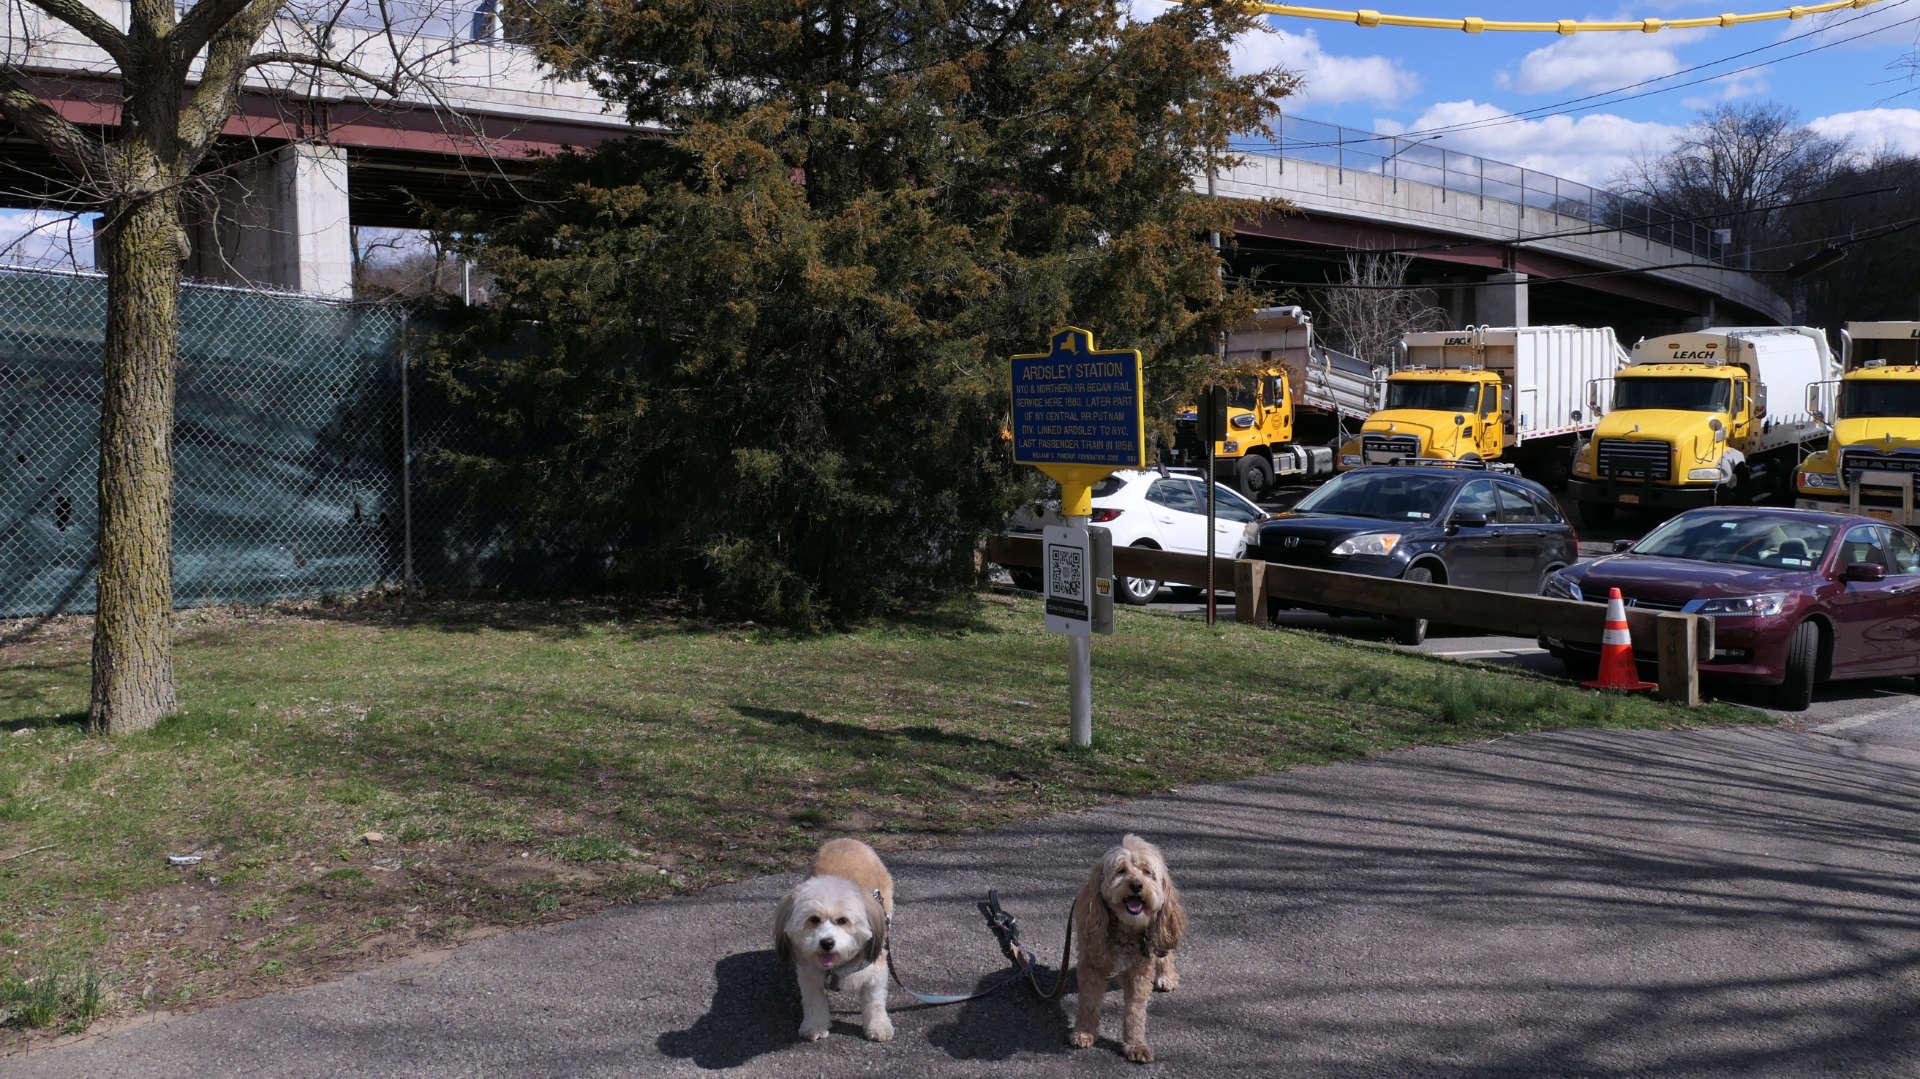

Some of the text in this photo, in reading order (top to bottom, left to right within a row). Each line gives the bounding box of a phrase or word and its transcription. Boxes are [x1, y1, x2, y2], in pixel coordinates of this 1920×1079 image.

[1672, 351, 1714, 359] LEACH
[1022, 362, 1123, 380] ARDSLEY STATION
[1114, 382, 1132, 392] RAIL
[1016, 398, 1044, 408] SERVICE
[1045, 398, 1064, 407] HERE
[1086, 397, 1110, 406] LATER
[1112, 396, 1133, 406] PART
[1046, 411, 1079, 420] CENTRAL
[1064, 426, 1098, 435] ARDSLEY
[1018, 439, 1036, 448] LAST
[1082, 440, 1104, 450] TRAIN
[1367, 444, 1413, 452] MACK
[1604, 468, 1666, 478] ACK
